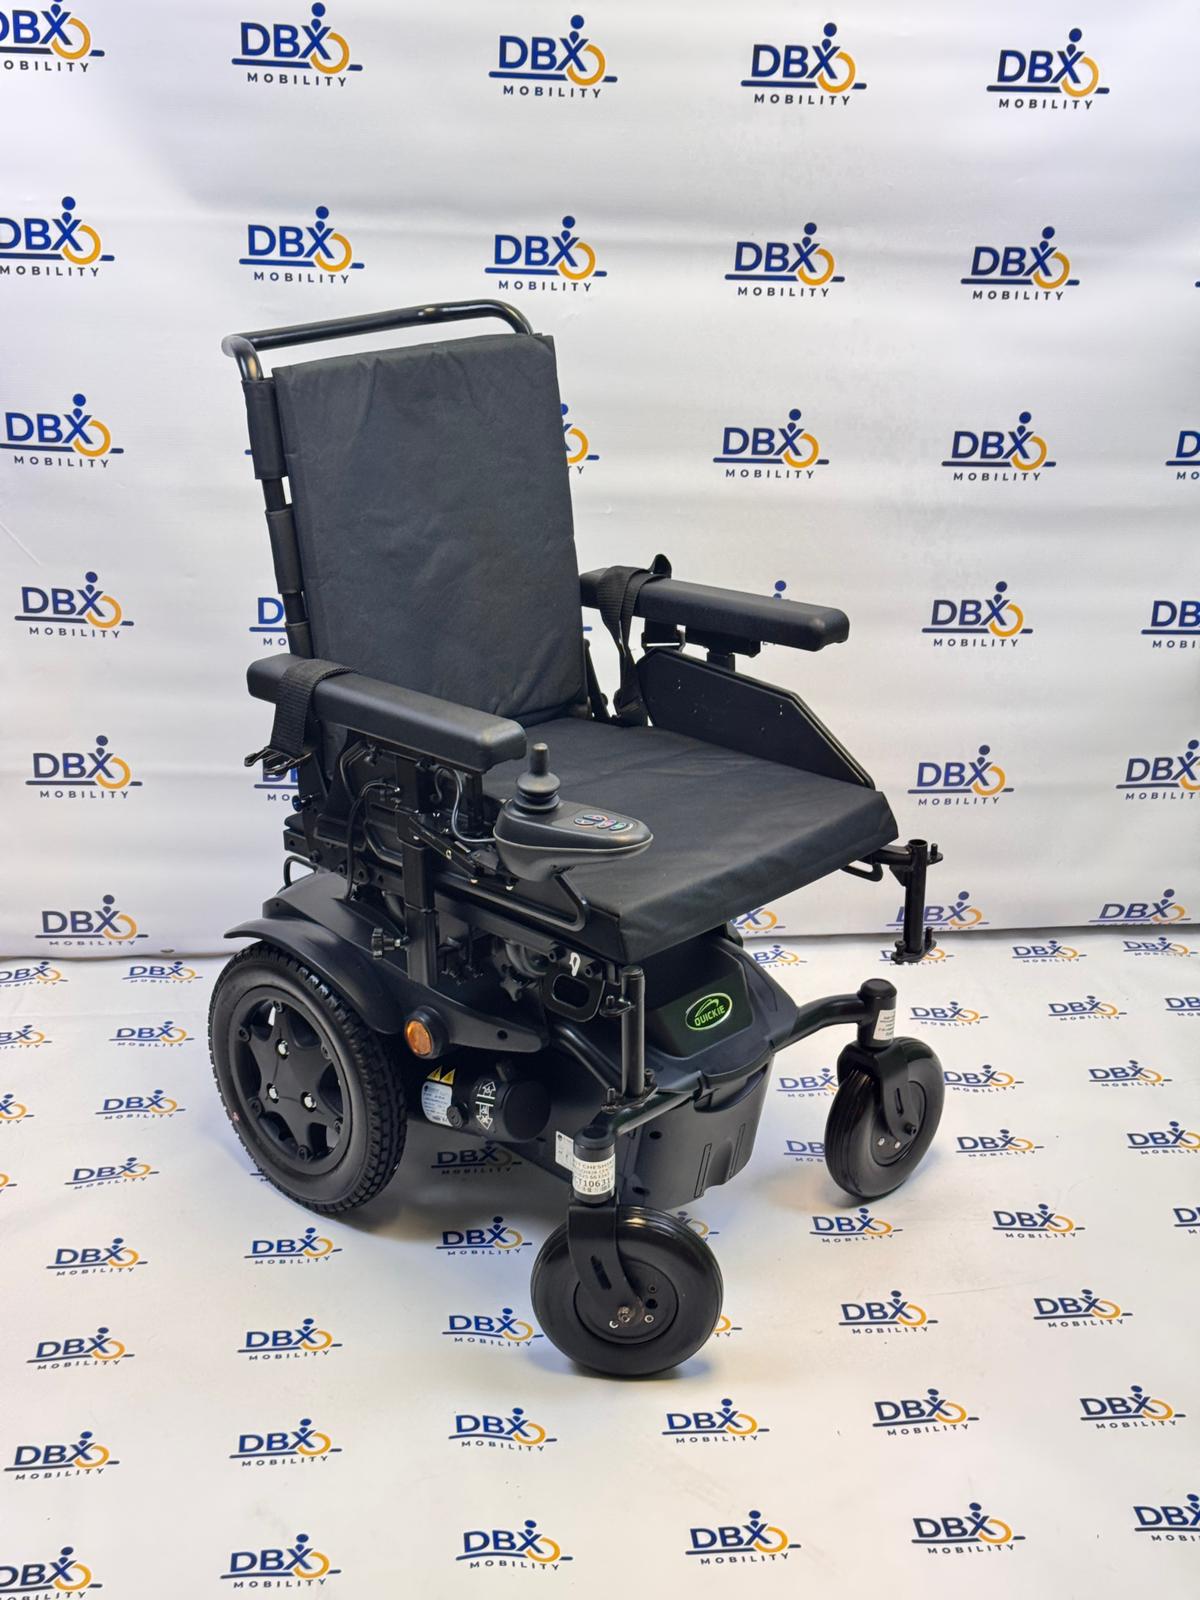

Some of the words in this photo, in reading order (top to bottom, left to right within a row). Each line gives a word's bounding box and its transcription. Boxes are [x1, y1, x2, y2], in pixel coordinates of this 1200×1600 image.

[240, 22, 332, 60] DBX
[499, 35, 589, 72] DBX
[751, 44, 841, 80] DBX
[4, 60, 88, 72] OBILITY
[997, 49, 1085, 84] DBX
[247, 72, 346, 87] MOBILITY
[503, 85, 601, 98] MOBILITY
[754, 94, 850, 105] MOBILITY
[999, 98, 1093, 110] MOBILITY
[248, 224, 335, 259] DBX
[494, 234, 580, 267] DBX
[734, 241, 820, 273] DBX
[971, 246, 1057, 277] DBX
[0, 265, 99, 277] MOBILITY
[254, 272, 349, 284] MOBILITY
[499, 280, 591, 292] MOBILITY
[738, 287, 829, 297] MOBILITY
[973, 290, 1063, 300] MOBILITY
[5, 412, 94, 445] DBX
[722, 427, 805, 457] DBX
[951, 431, 1034, 460] DBX
[14, 455, 108, 468] MOBILITY
[726, 469, 814, 479] MOBILITY
[953, 472, 1040, 481] MOBILITY
[21, 586, 106, 617] DBX
[931, 599, 1010, 626] DBX
[1150, 600, 1200, 627] DB
[29, 627, 120, 638] MOBILITY
[933, 638, 1018, 647] MOBILITY
[1152, 640, 1196, 648] MOBI
[33, 752, 115, 779] DBX
[1125, 756, 1200, 782] DBX
[917, 762, 992, 787] DBX
[918, 797, 999, 805] MOBILITY
[1099, 902, 1175, 919] DBX
[42, 911, 121, 933] DBX
[694, 1004, 726, 1027] QUICKIE
[1127, 1130, 1192, 1146] DBX
[73, 1163, 138, 1181] DBX
[74, 1177, 146, 1189] MOBILITY
[812, 1216, 879, 1232] DBX
[993, 1210, 1060, 1227] DBX
[252, 1236, 319, 1254] DBX
[442, 1229, 509, 1245] DBX
[822, 1234, 893, 1243] MOBILITY
[55, 1247, 126, 1265] DBX
[255, 1256, 330, 1264] MOBILITY
[57, 1267, 134, 1276] MOBILITY
[841, 1301, 913, 1321] DBX
[1033, 1297, 1107, 1315] DBX
[449, 1315, 519, 1335] DBX
[1048, 1319, 1123, 1328] MOBILITY
[246, 1328, 317, 1348] DBX
[454, 1337, 532, 1347] MOBILITY
[36, 1337, 111, 1358] DBX
[249, 1350, 329, 1360] MOBILITY
[37, 1360, 120, 1370] MOBILITY
[874, 1399, 952, 1421] DBX
[1080, 1396, 1159, 1416] DBX
[455, 1414, 530, 1437] DBX
[666, 1411, 743, 1430] DBX
[1096, 1420, 1176, 1429] MOBILITY
[887, 1424, 968, 1436] MOBILITY
[238, 1430, 316, 1453] DBX
[461, 1440, 544, 1451] MOBILITY
[14, 1443, 95, 1466] DBX
[242, 1456, 328, 1467] MOBILITY
[15, 1468, 104, 1480] MOBILITY
[1133, 1506, 1200, 1526] DB
[912, 1515, 996, 1538] DBX
[463, 1530, 544, 1554] DBX
[690, 1523, 772, 1549] DBX
[927, 1544, 1013, 1554] MOBILITY
[230, 1548, 313, 1573] DBX
[470, 1560, 559, 1570] MOBILITY
[700, 1553, 788, 1565] MOBILITY
[234, 1578, 326, 1588] MOBILITY
